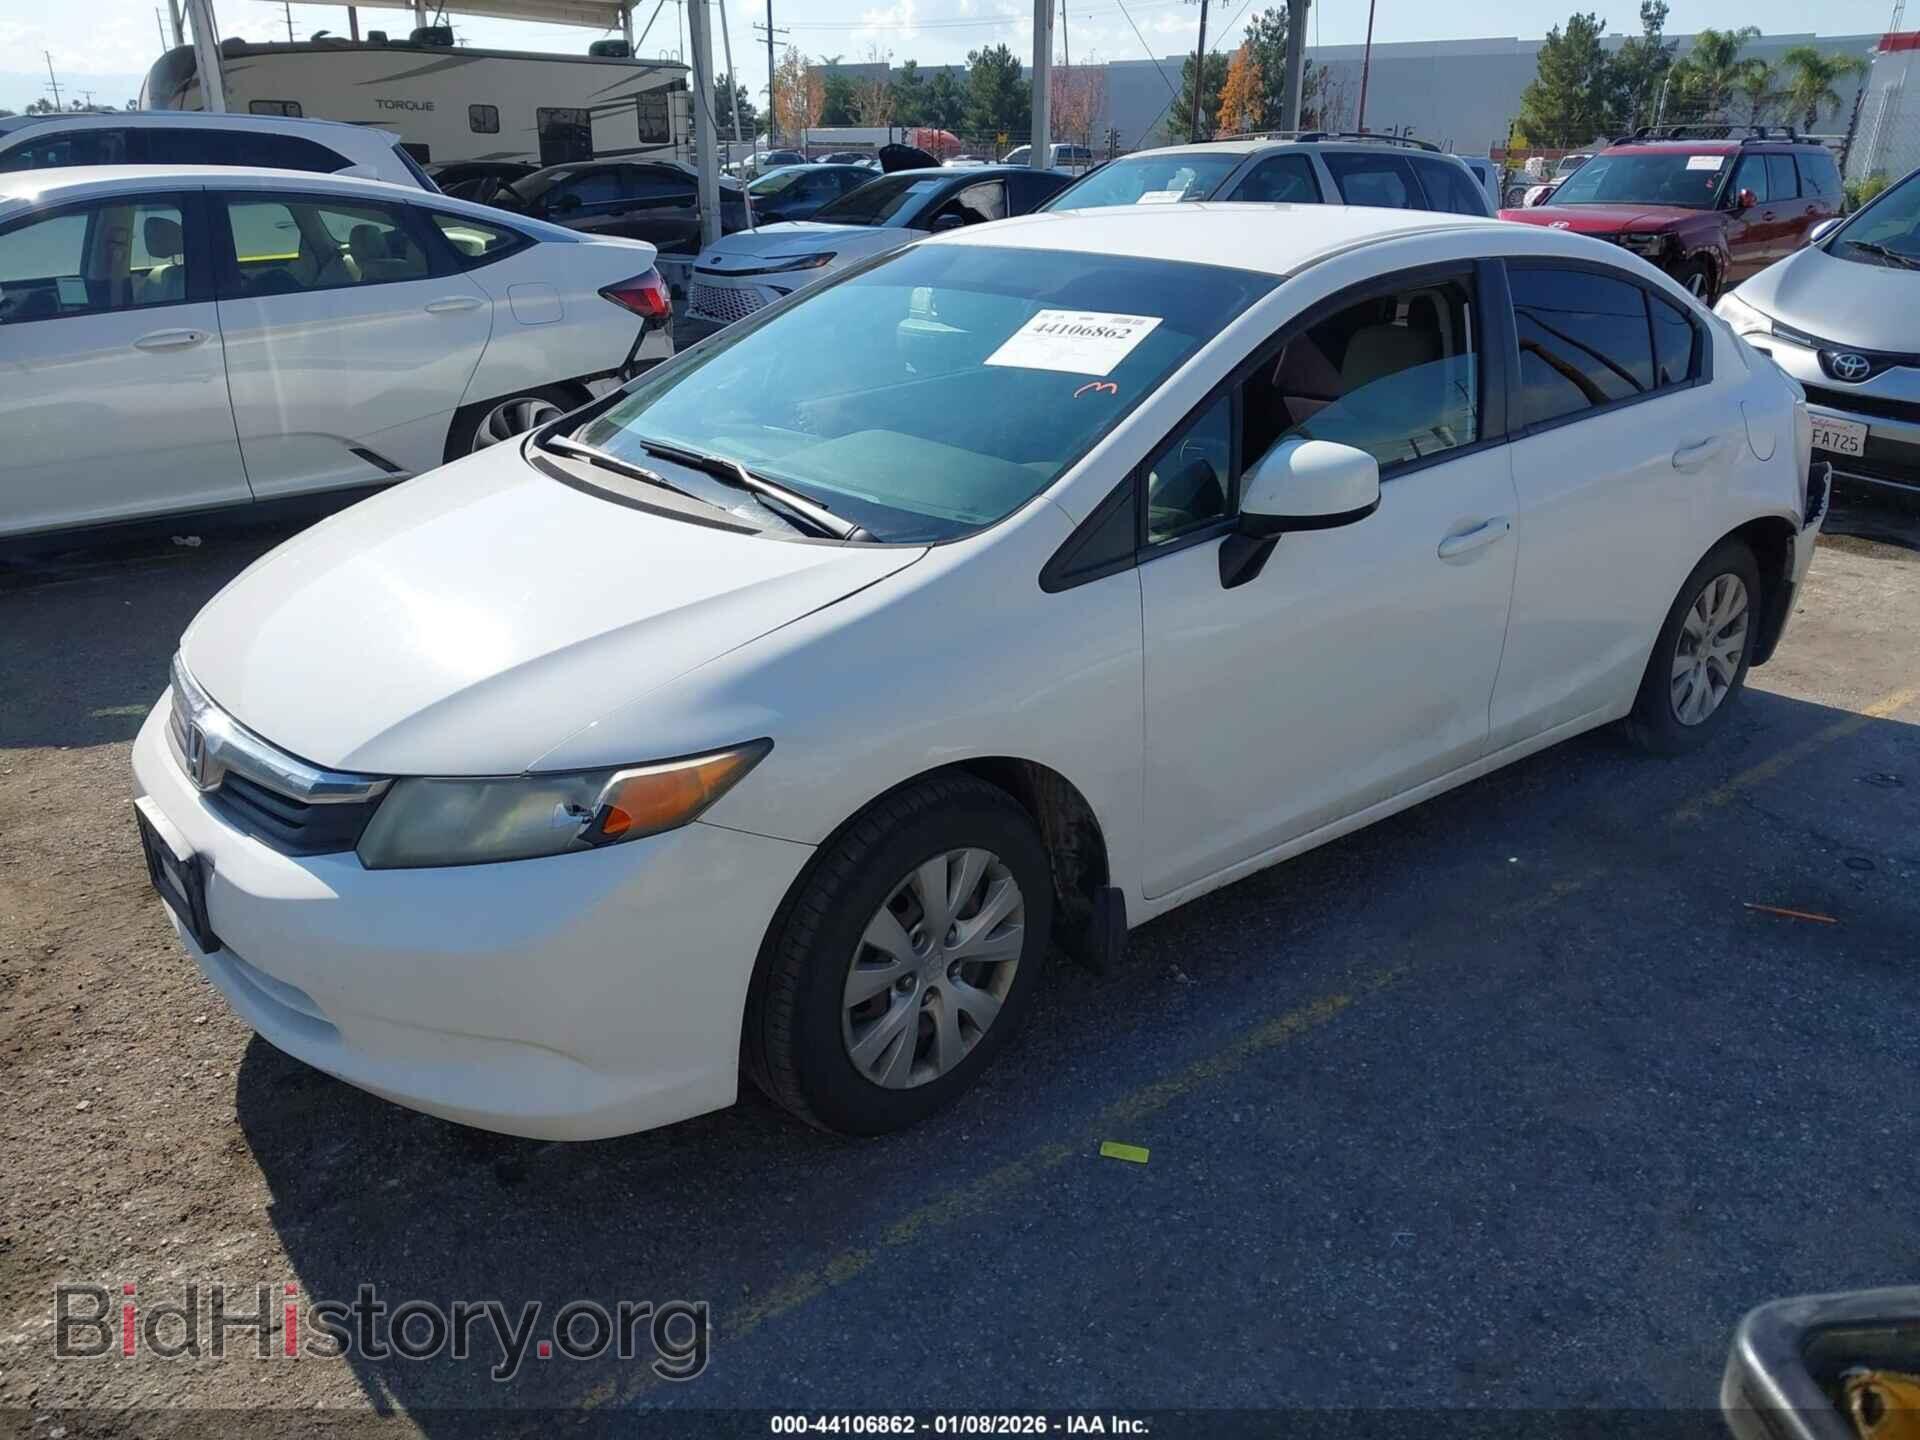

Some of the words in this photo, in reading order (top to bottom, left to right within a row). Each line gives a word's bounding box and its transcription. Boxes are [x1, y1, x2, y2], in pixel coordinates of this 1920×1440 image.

[375, 99, 435, 111] TORQUE
[1034, 323, 1131, 339] 44106862
[1812, 429, 1858, 452] FA725
